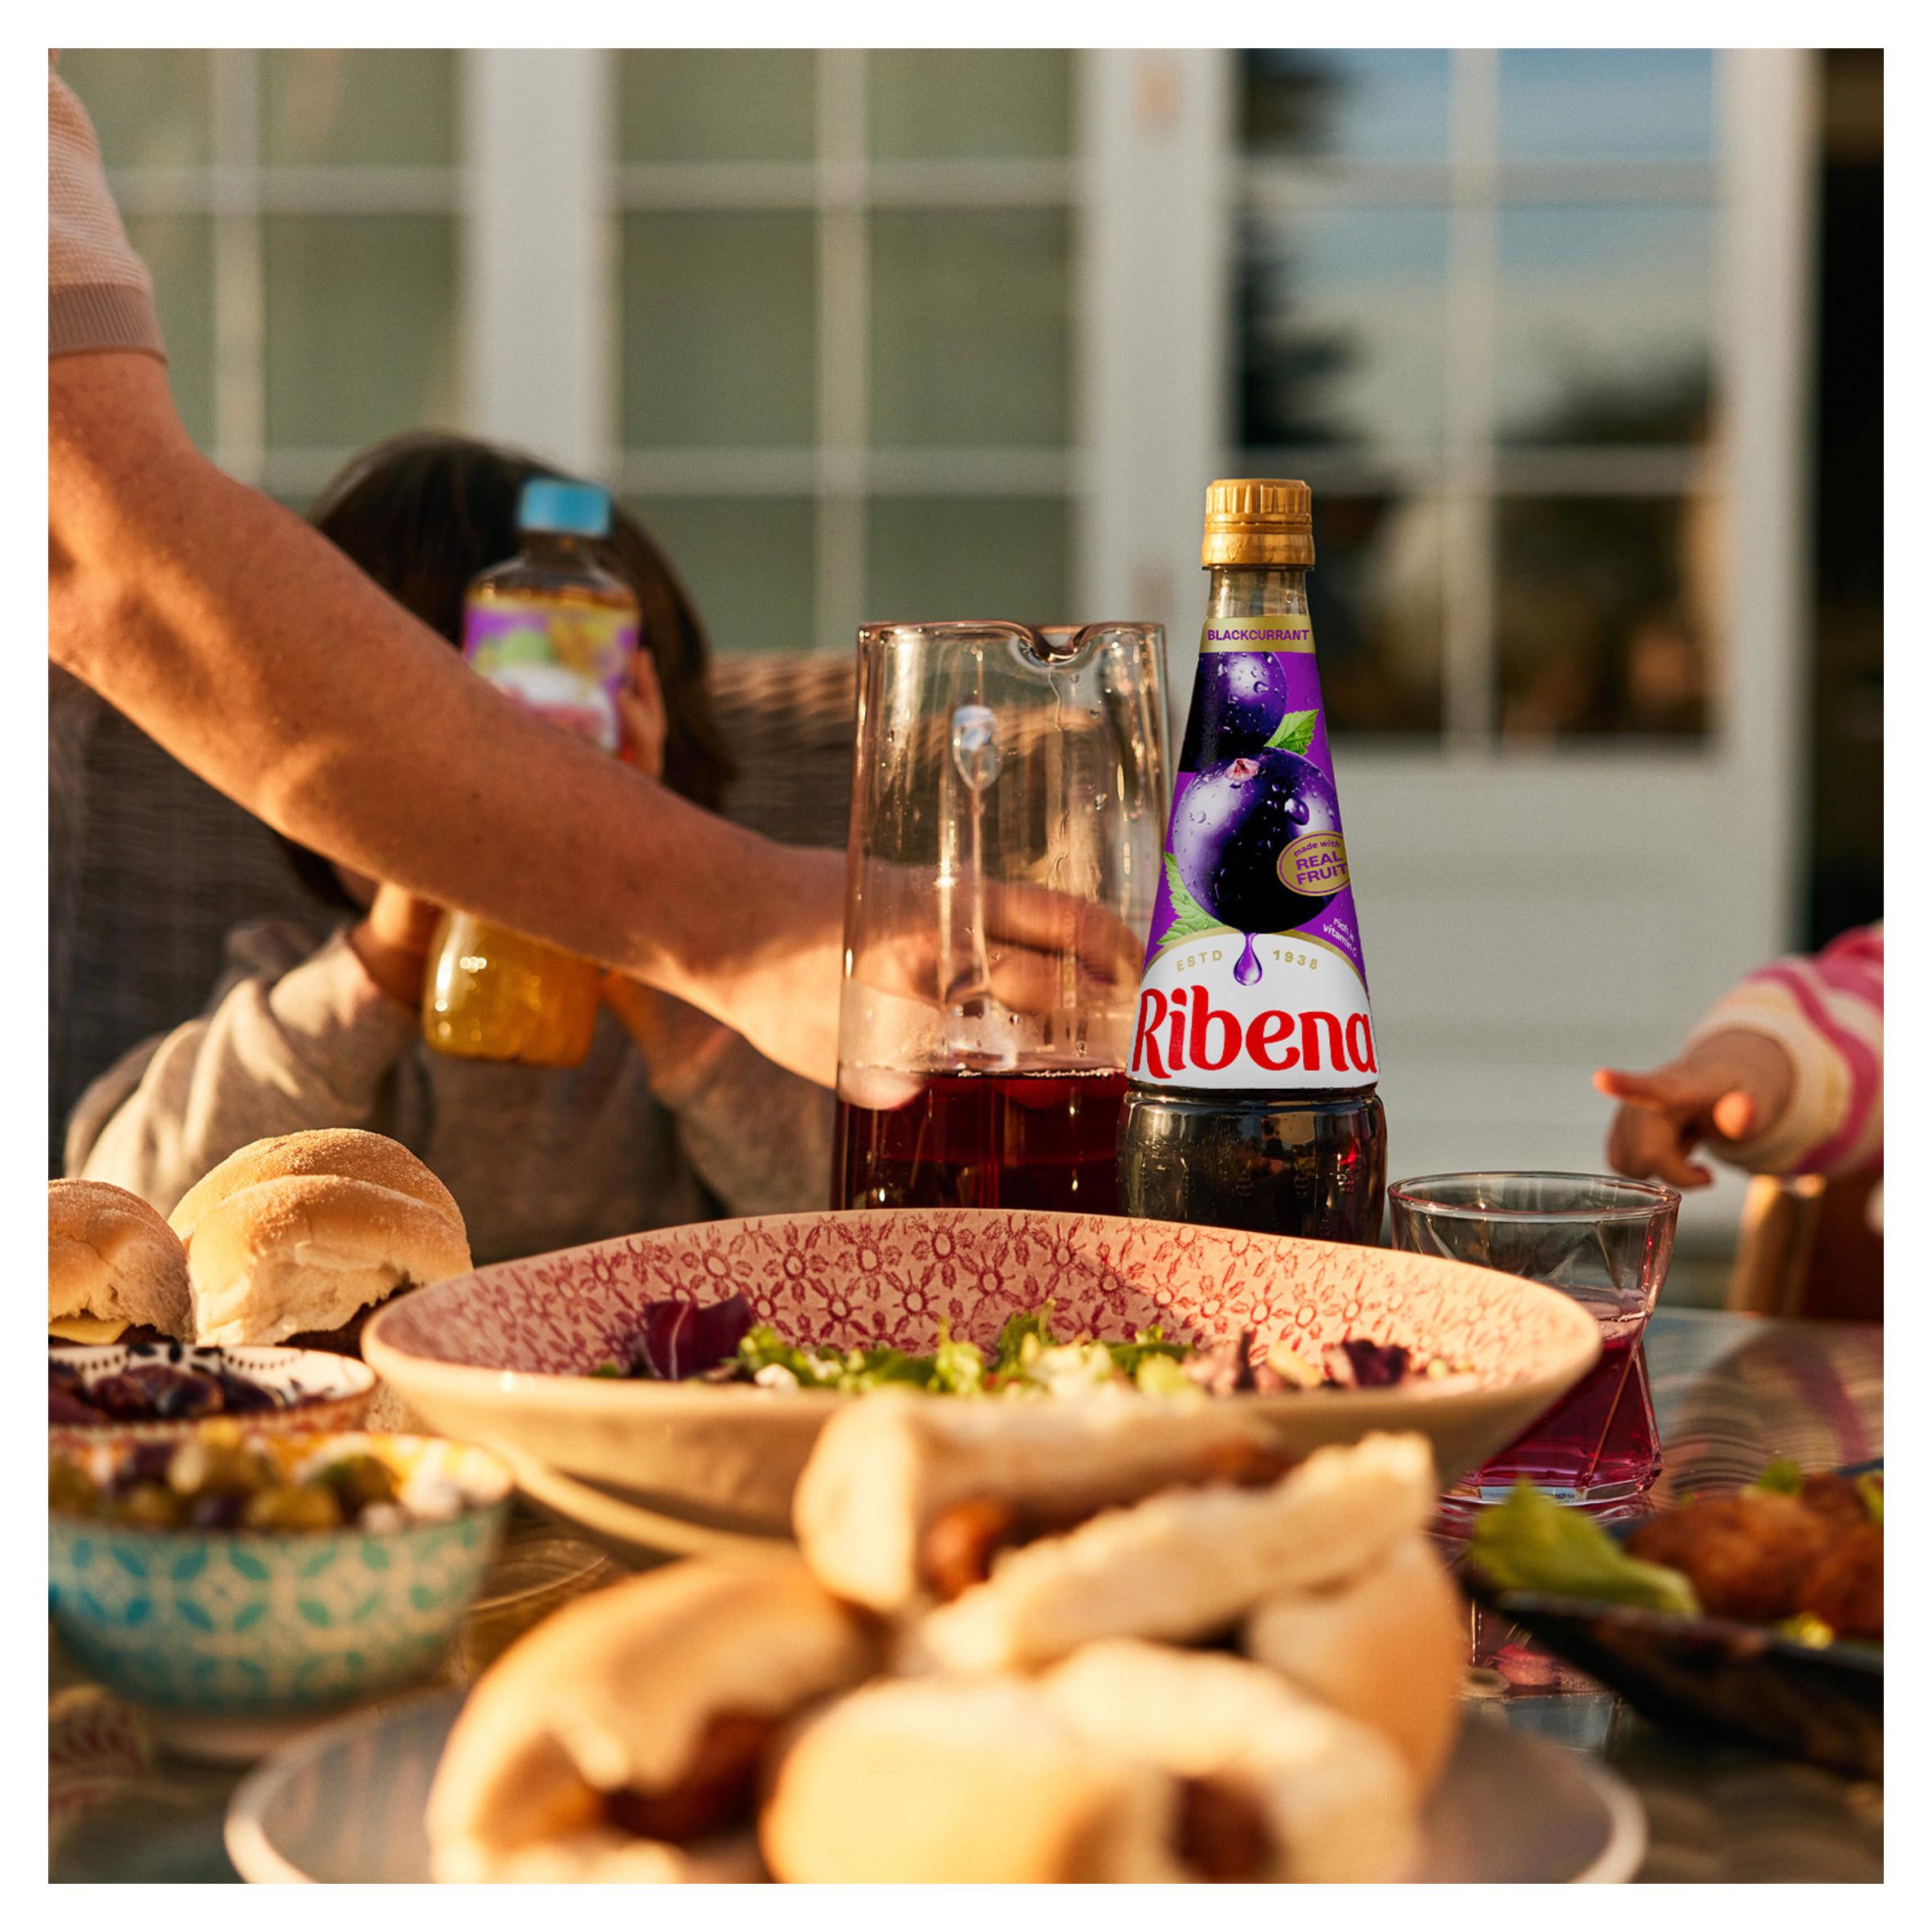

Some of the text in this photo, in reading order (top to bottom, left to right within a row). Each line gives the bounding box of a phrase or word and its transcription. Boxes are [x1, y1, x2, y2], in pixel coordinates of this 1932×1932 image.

[1207, 629, 1310, 640] BLACKCURRANT
[1294, 839, 1341, 857] made with
[1296, 850, 1344, 871] REAL
[1296, 863, 1348, 886] FRUIT
[1333, 917, 1349, 935] rich
[1323, 924, 1353, 952] vitamin
[1176, 949, 1318, 972] ESTD 1938
[1131, 985, 1377, 1079] Ribena
